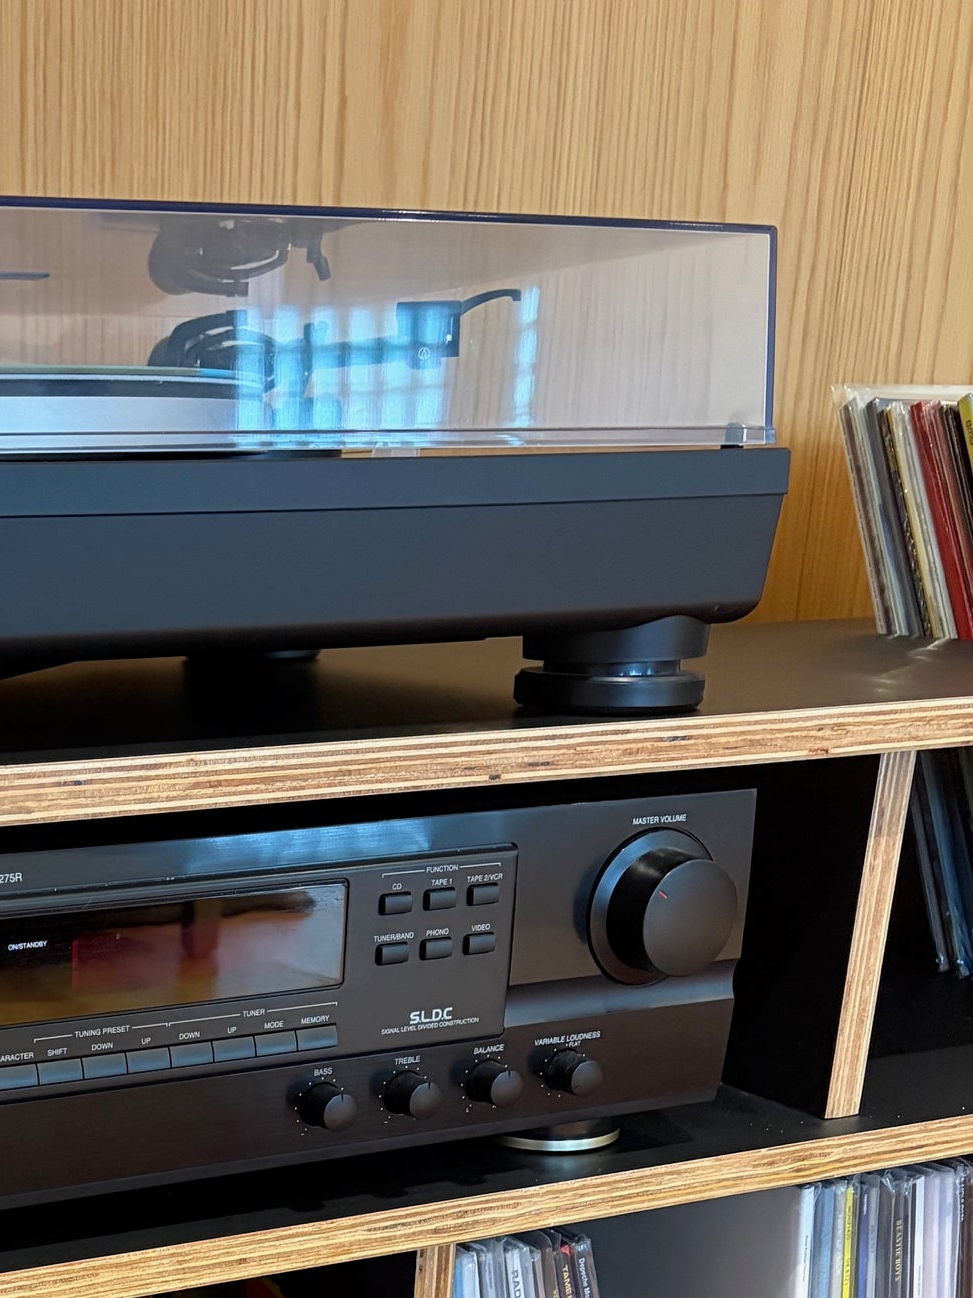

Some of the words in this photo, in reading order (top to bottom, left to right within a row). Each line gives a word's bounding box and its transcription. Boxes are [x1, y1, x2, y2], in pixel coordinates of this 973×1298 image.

[633, 815, 659, 825] MASTER
[660, 814, 687, 822] VOLUME
[426, 864, 459, 873] FUNCTION
[431, 878, 447, 886] TAPE
[467, 874, 483, 882] TAPE
[484, 873, 503, 881] 2/VCR
[426, 928, 449, 936] PHONO
[373, 932, 414, 942] TUNER/BAND
[8, 940, 47, 951] ON/STANDBY
[243, 1009, 265, 1017] TUNER
[300, 1015, 329, 1024] MEMORY
[264, 1021, 283, 1029] MODE
[381, 1027, 400, 1035] SIGNAL
[439, 1017, 479, 1027] CONSTRUCTION
[75, 1029, 101, 1038] TUNING
[103, 1025, 130, 1034] PRESET
[227, 1026, 236, 1034] UP
[179, 1031, 200, 1040] DOWN
[534, 1035, 565, 1046] VARIABLE
[566, 1031, 601, 1042] LOUDNESS
[141, 1037, 151, 1045] UP
[91, 1042, 113, 1051] DOWN
[473, 1044, 504, 1054] BALANCE
[47, 1048, 67, 1057] SHIFT
[395, 1055, 421, 1065] TREBLE
[314, 1067, 333, 1076] BASS
[894, 1219, 902, 1256] BEASTIE
[577, 1256, 589, 1288] Depeche
[561, 1264, 572, 1295] TAME
